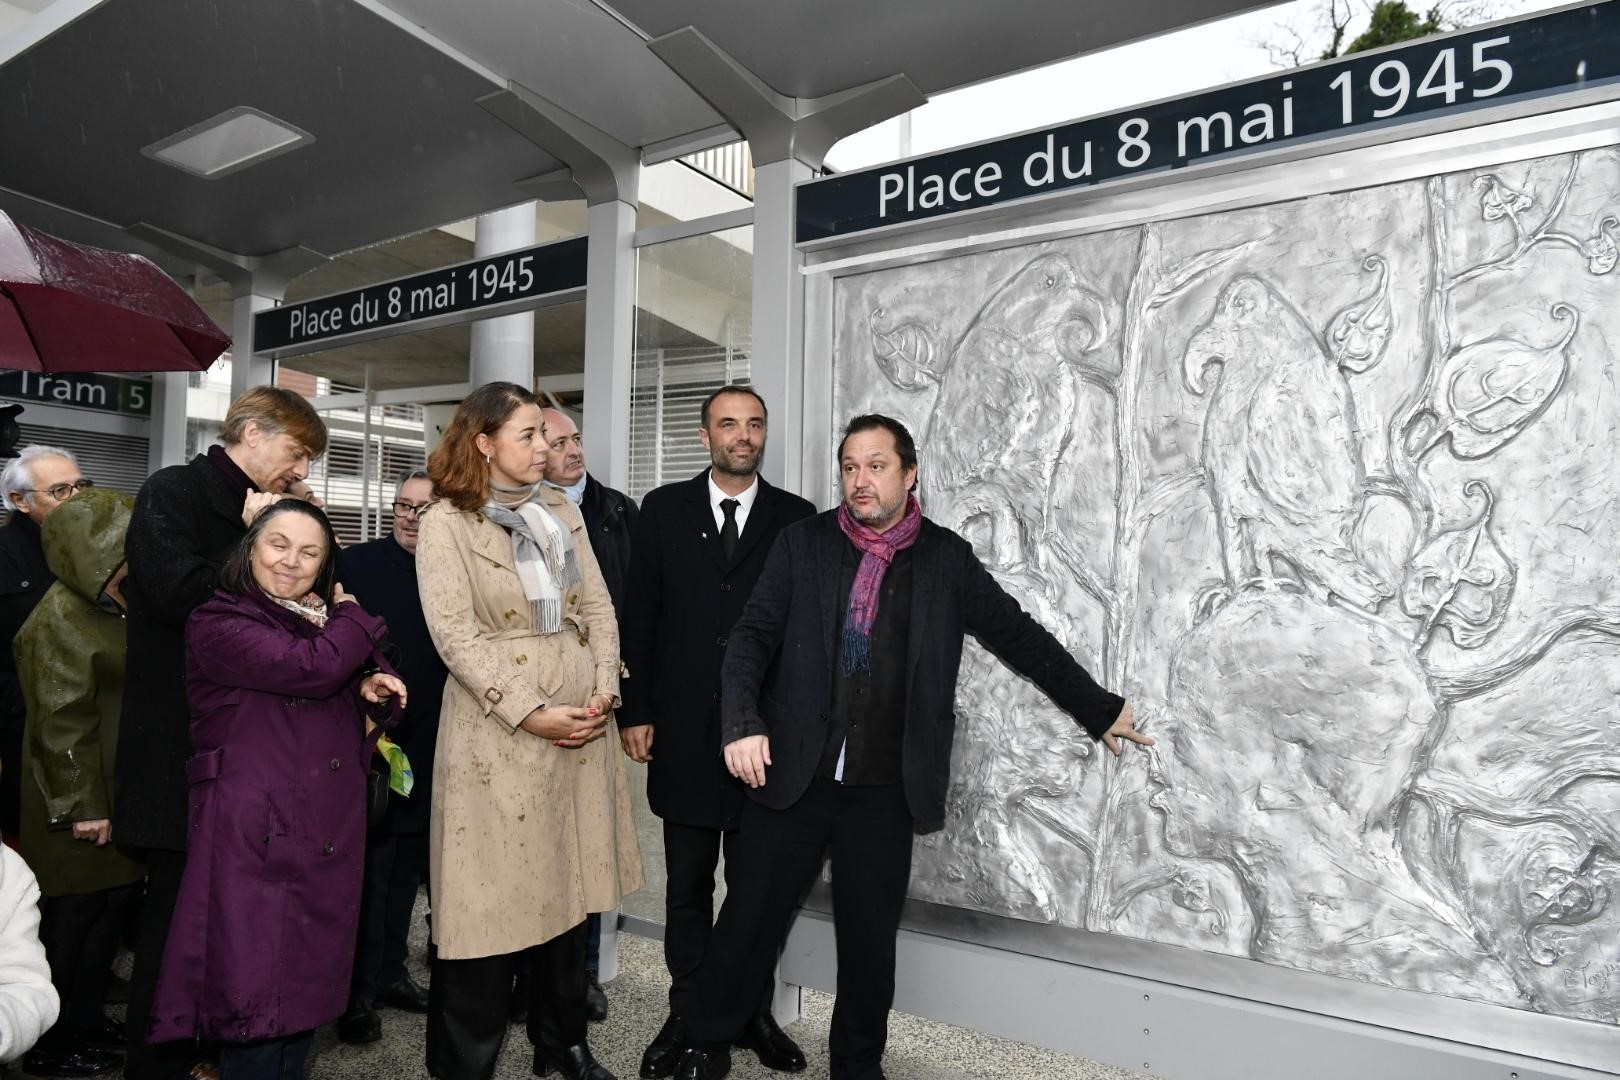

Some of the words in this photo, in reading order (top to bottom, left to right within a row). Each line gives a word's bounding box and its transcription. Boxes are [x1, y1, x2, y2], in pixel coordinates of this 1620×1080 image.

[879, 161, 1002, 218] Place
[1024, 133, 1092, 187] du
[1117, 117, 1151, 168] 8
[1177, 80, 1293, 158] mai
[1329, 35, 1514, 125] 1945
[289, 306, 342, 339] Place
[351, 292, 379, 326] du
[388, 286, 402, 318] 8
[410, 271, 456, 314] mai
[468, 255, 534, 301] 1945
[130, 385, 144, 409] 5
